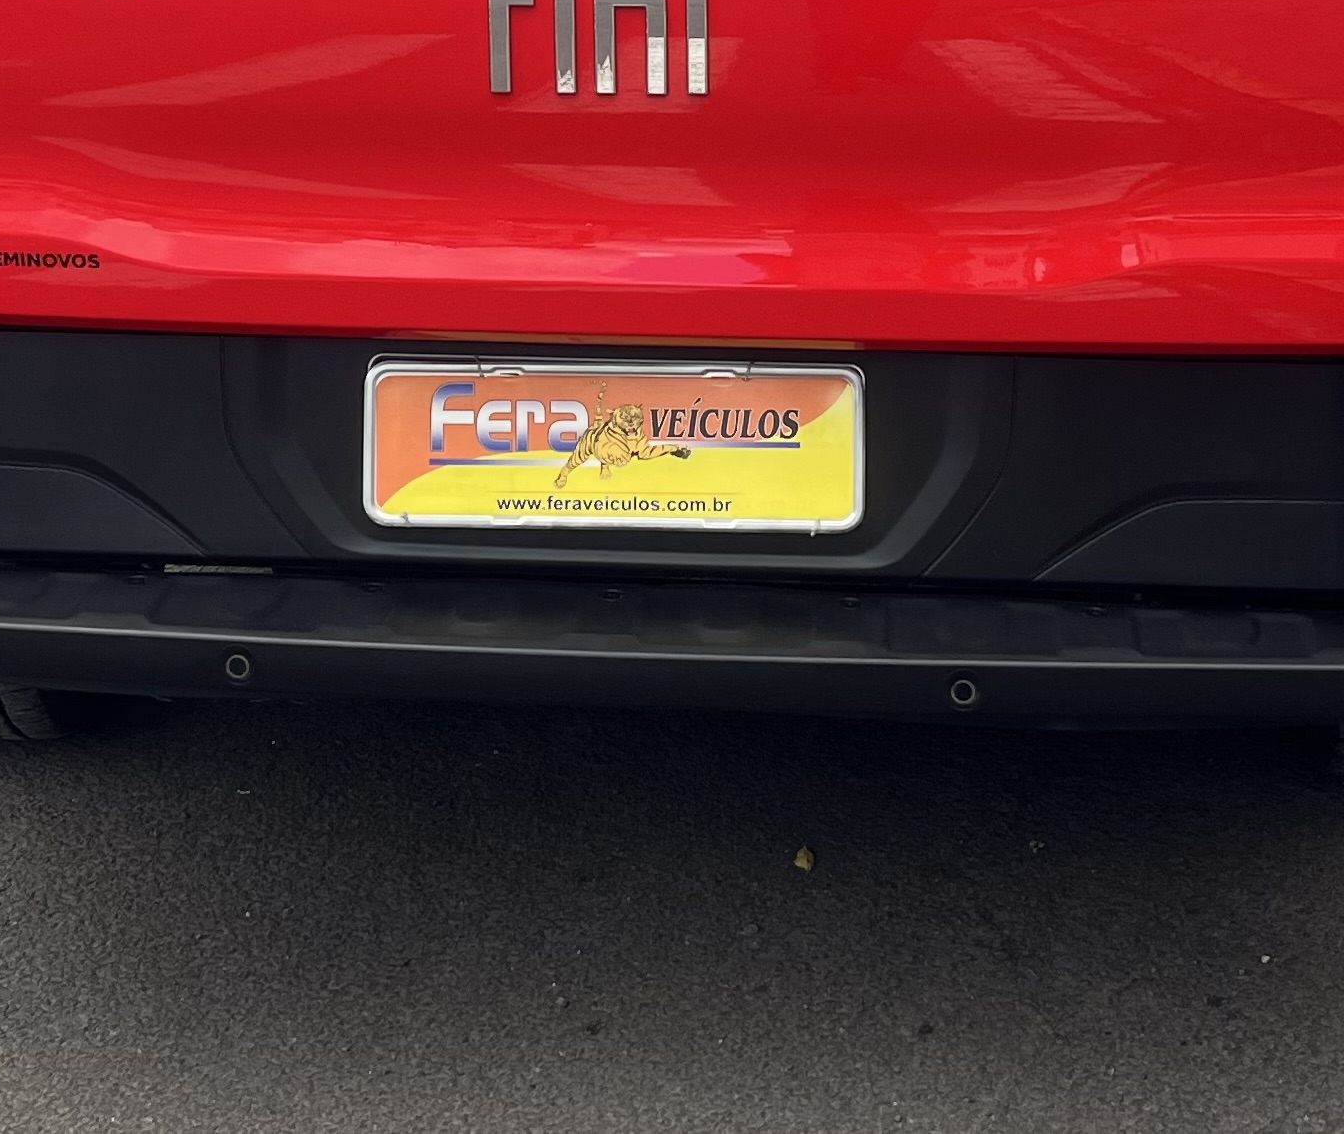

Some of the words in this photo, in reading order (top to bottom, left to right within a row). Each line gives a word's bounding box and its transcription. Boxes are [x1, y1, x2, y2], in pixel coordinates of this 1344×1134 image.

[429, 381, 591, 453] Fera
[649, 398, 800, 439] VEÍCULOS
[496, 494, 733, 513] www.feraveiculos.com.br
